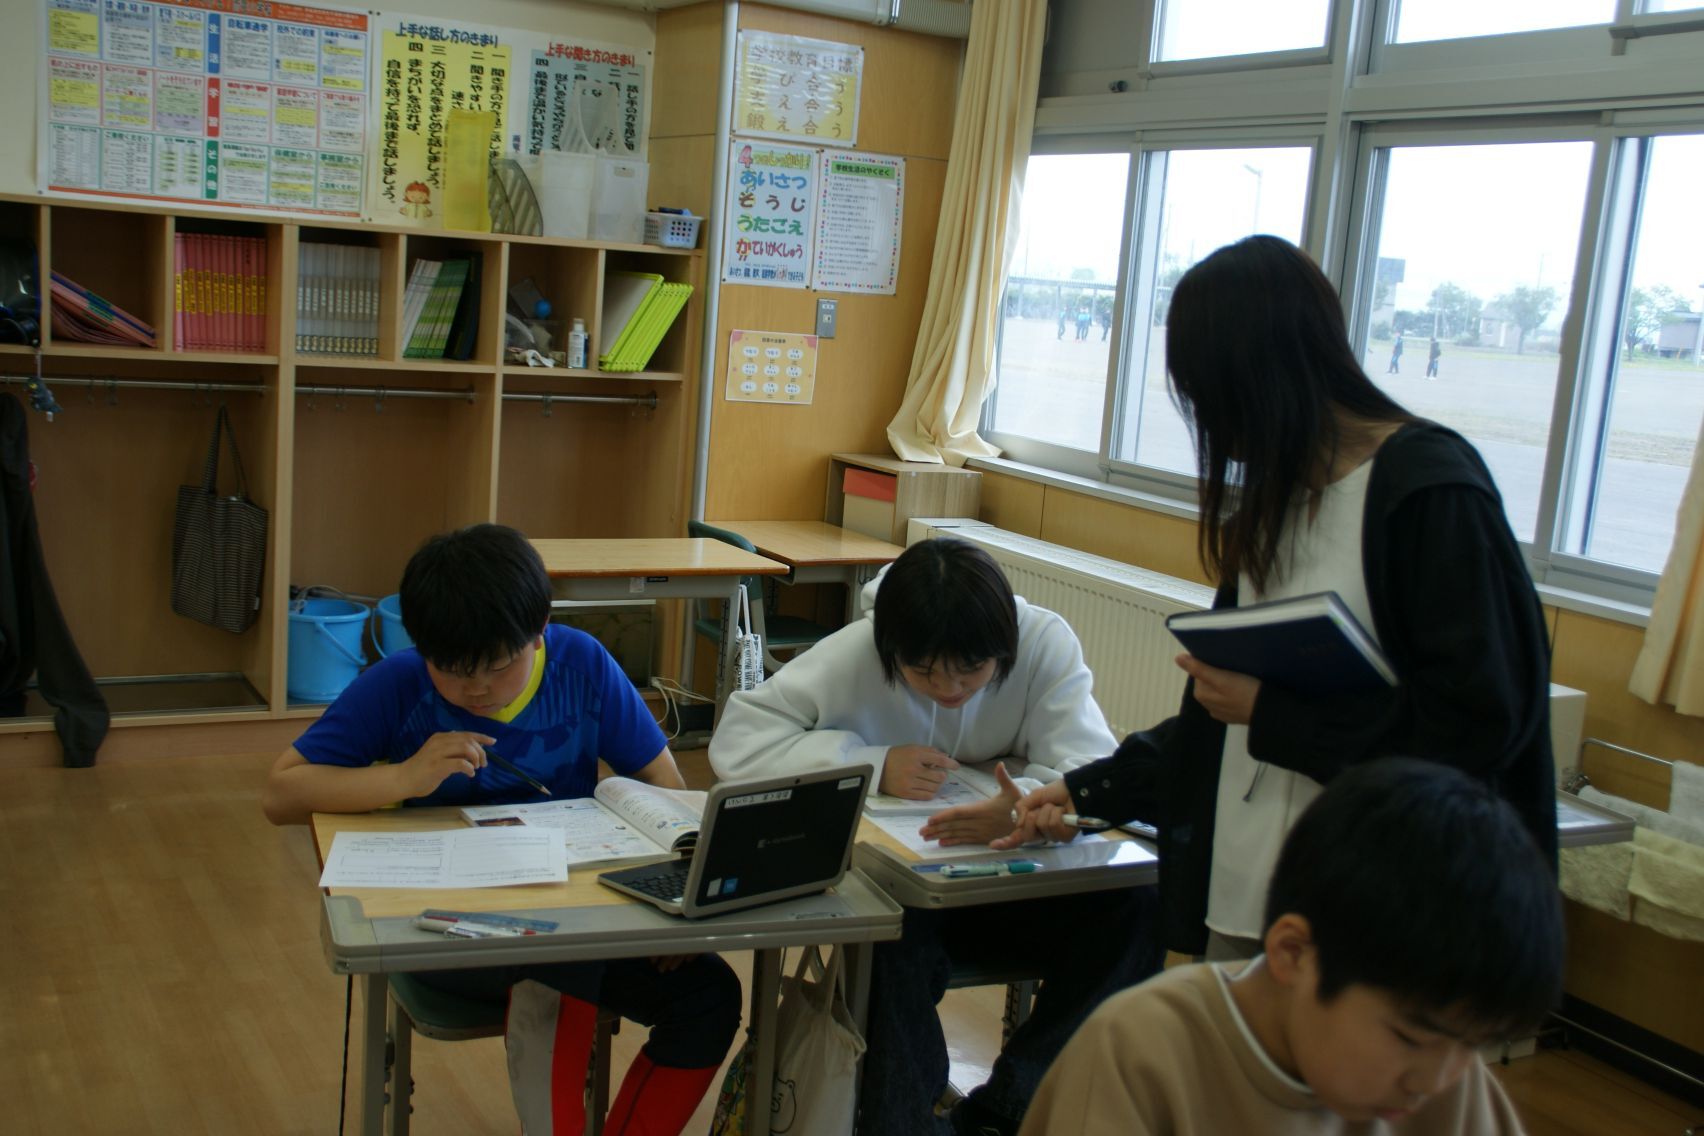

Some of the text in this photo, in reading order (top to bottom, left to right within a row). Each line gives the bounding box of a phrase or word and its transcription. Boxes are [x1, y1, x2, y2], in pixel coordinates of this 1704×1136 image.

[395, 22, 499, 48] 上手な話し方のきまり
[544, 41, 636, 68] 上手な聞き方のきまり
[750, 44, 854, 74] 学校教育目標
[740, 170, 808, 190] あいさつ
[835, 164, 891, 177] 学校生活のやくそく
[739, 191, 806, 213] そうじ
[736, 238, 804, 260] かていがくしゅう
